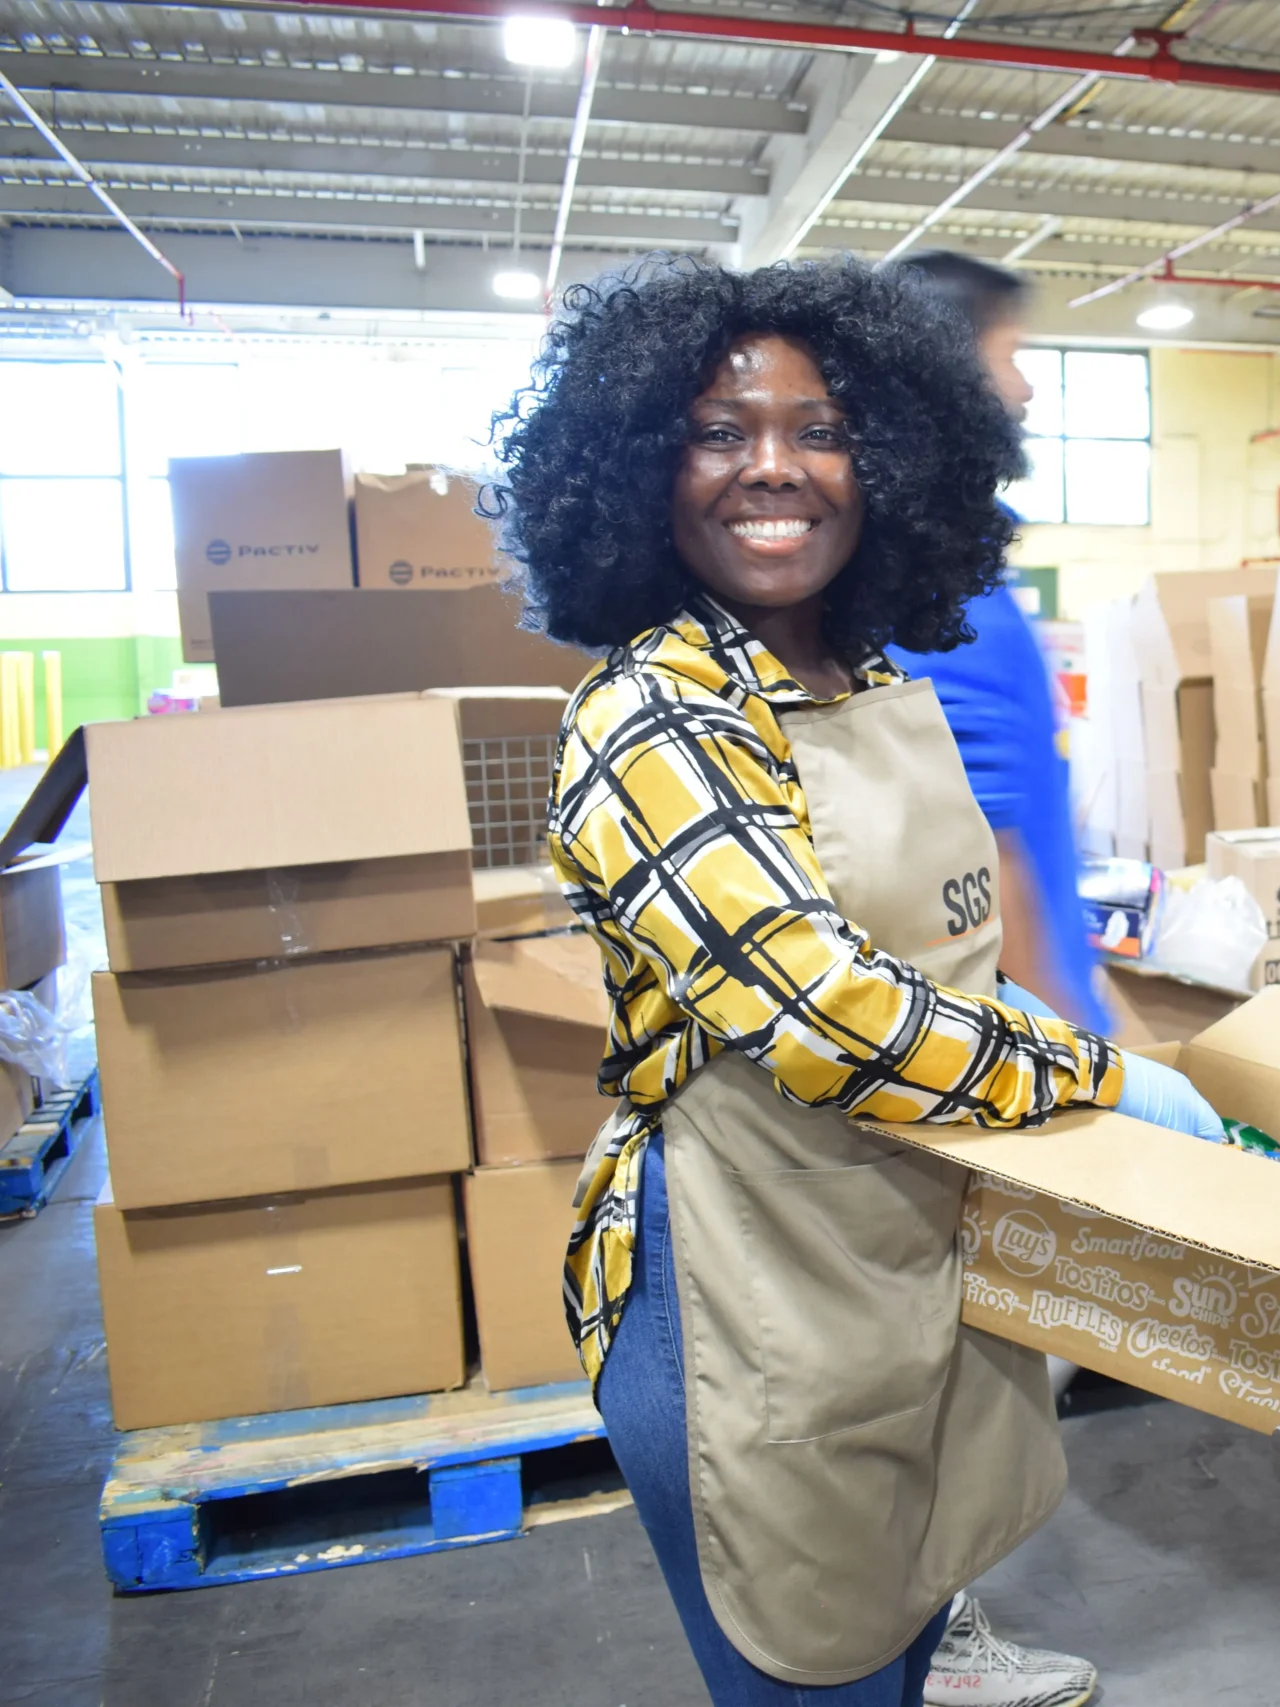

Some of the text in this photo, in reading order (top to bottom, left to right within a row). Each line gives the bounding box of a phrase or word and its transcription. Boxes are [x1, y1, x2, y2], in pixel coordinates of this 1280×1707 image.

[942, 866, 991, 936] SGS
[997, 1218, 1054, 1262] Lay's
[1071, 1226, 1187, 1262] Smartfood
[1028, 1290, 1123, 1347] RUFFLES
[1127, 1318, 1215, 1361] Cheetos
